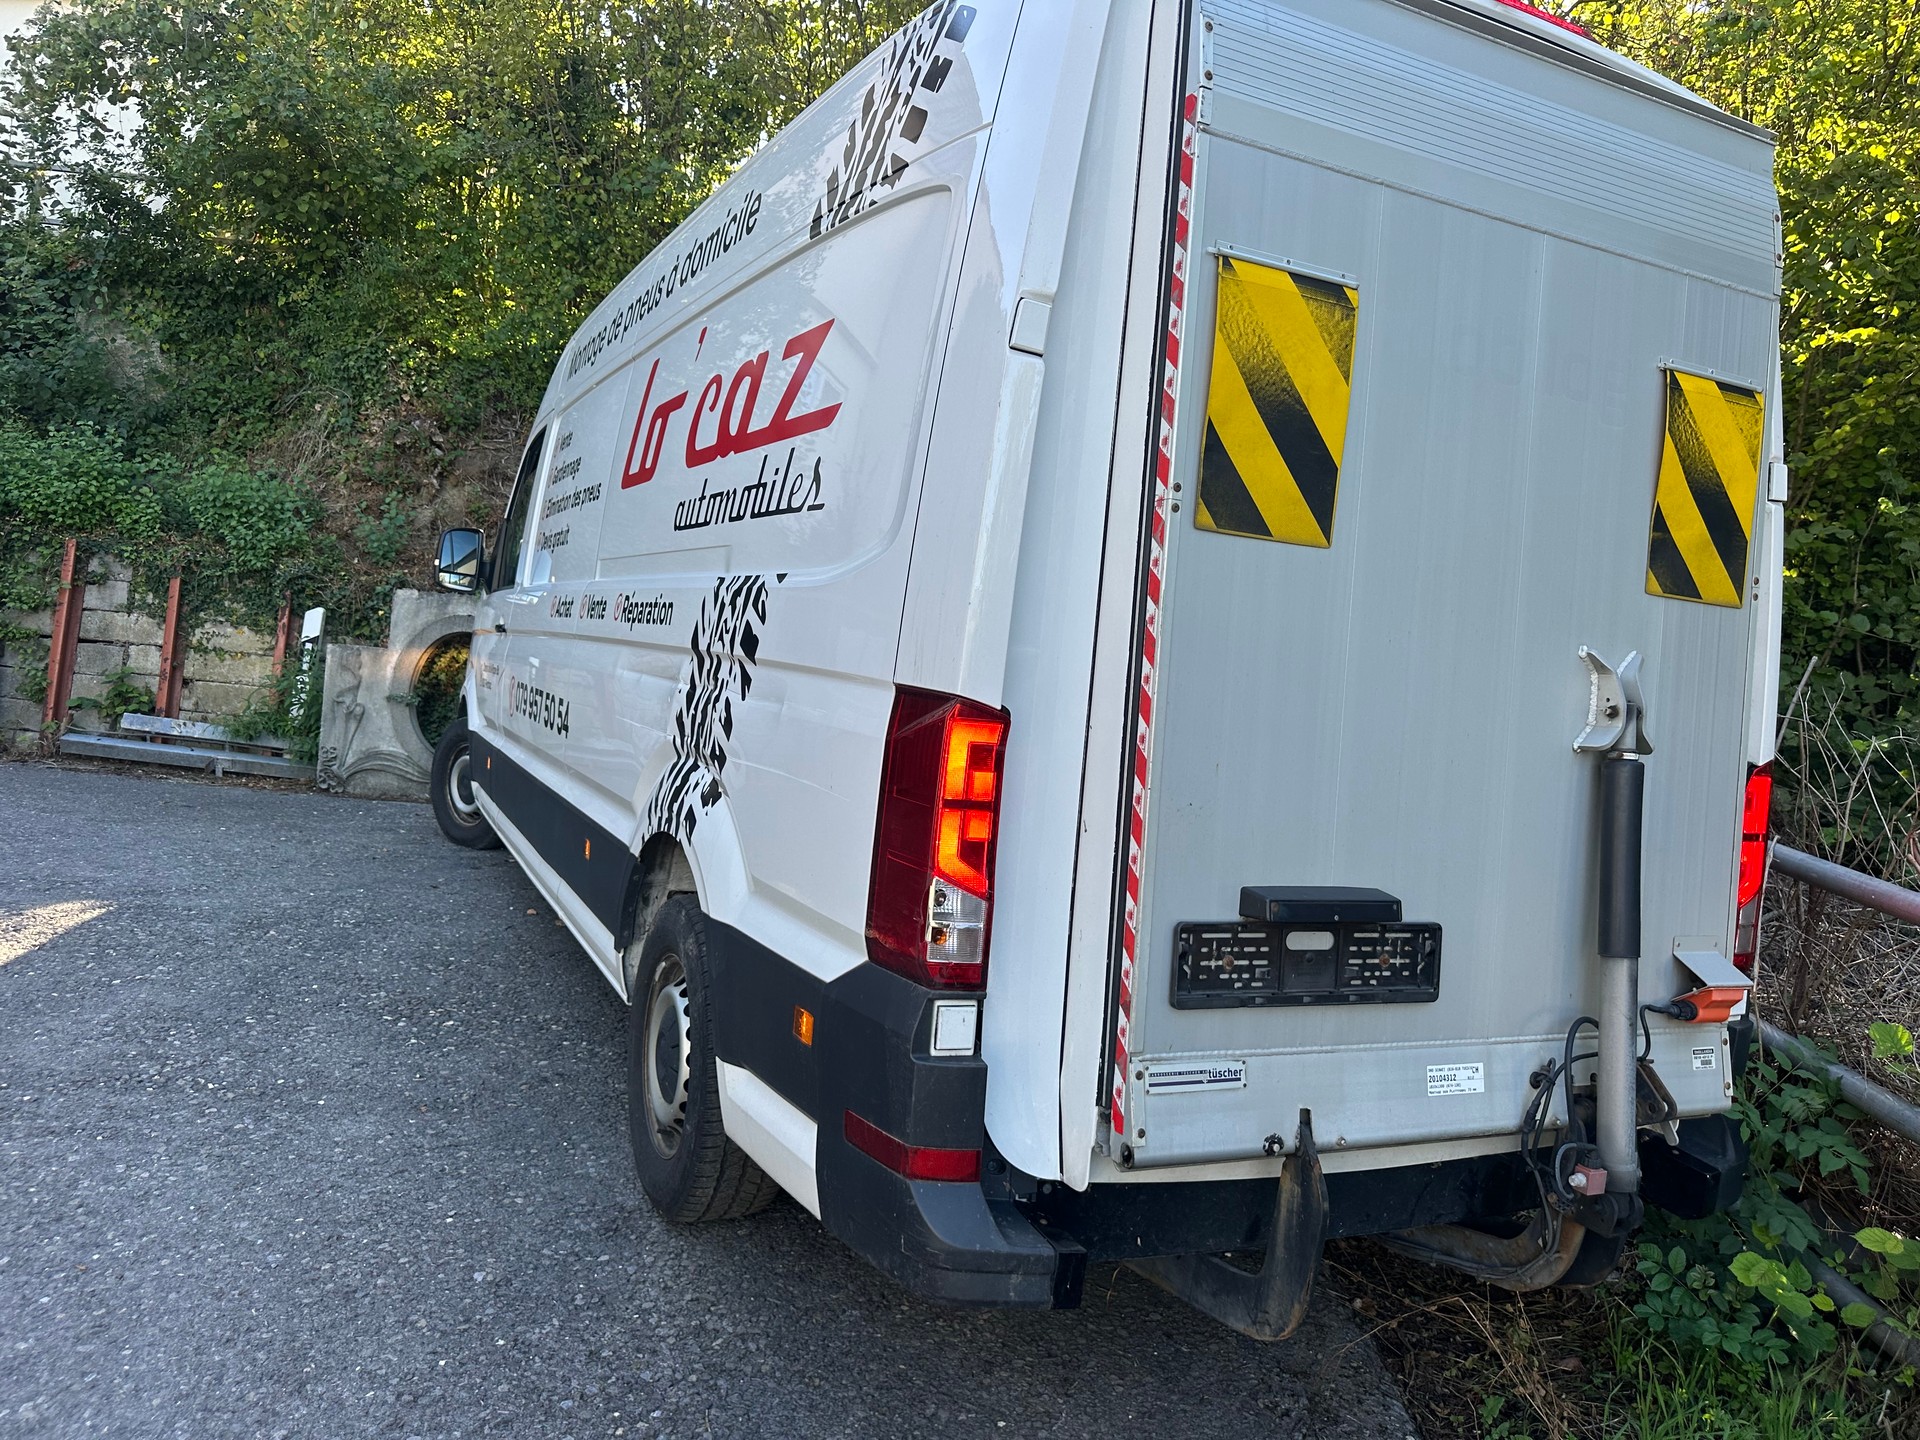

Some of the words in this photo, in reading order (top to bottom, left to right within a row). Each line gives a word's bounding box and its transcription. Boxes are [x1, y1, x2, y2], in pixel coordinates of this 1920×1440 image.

[607, 307, 624, 347] de
[621, 275, 666, 343] pneus
[665, 254, 680, 299] à
[680, 189, 762, 287] domicile
[580, 482, 602, 511] pneus
[674, 447, 825, 532] automobiles
[555, 594, 575, 619] Achat
[586, 593, 608, 620] Vente
[620, 590, 675, 632] Réparation
[515, 680, 529, 717] 079
[528, 685, 544, 724] 957
[543, 691, 556, 731] 50
[556, 697, 570, 739] 54
[1208, 1067, 1243, 1079] tüscher
[1428, 1073, 1457, 1083] 20104312
